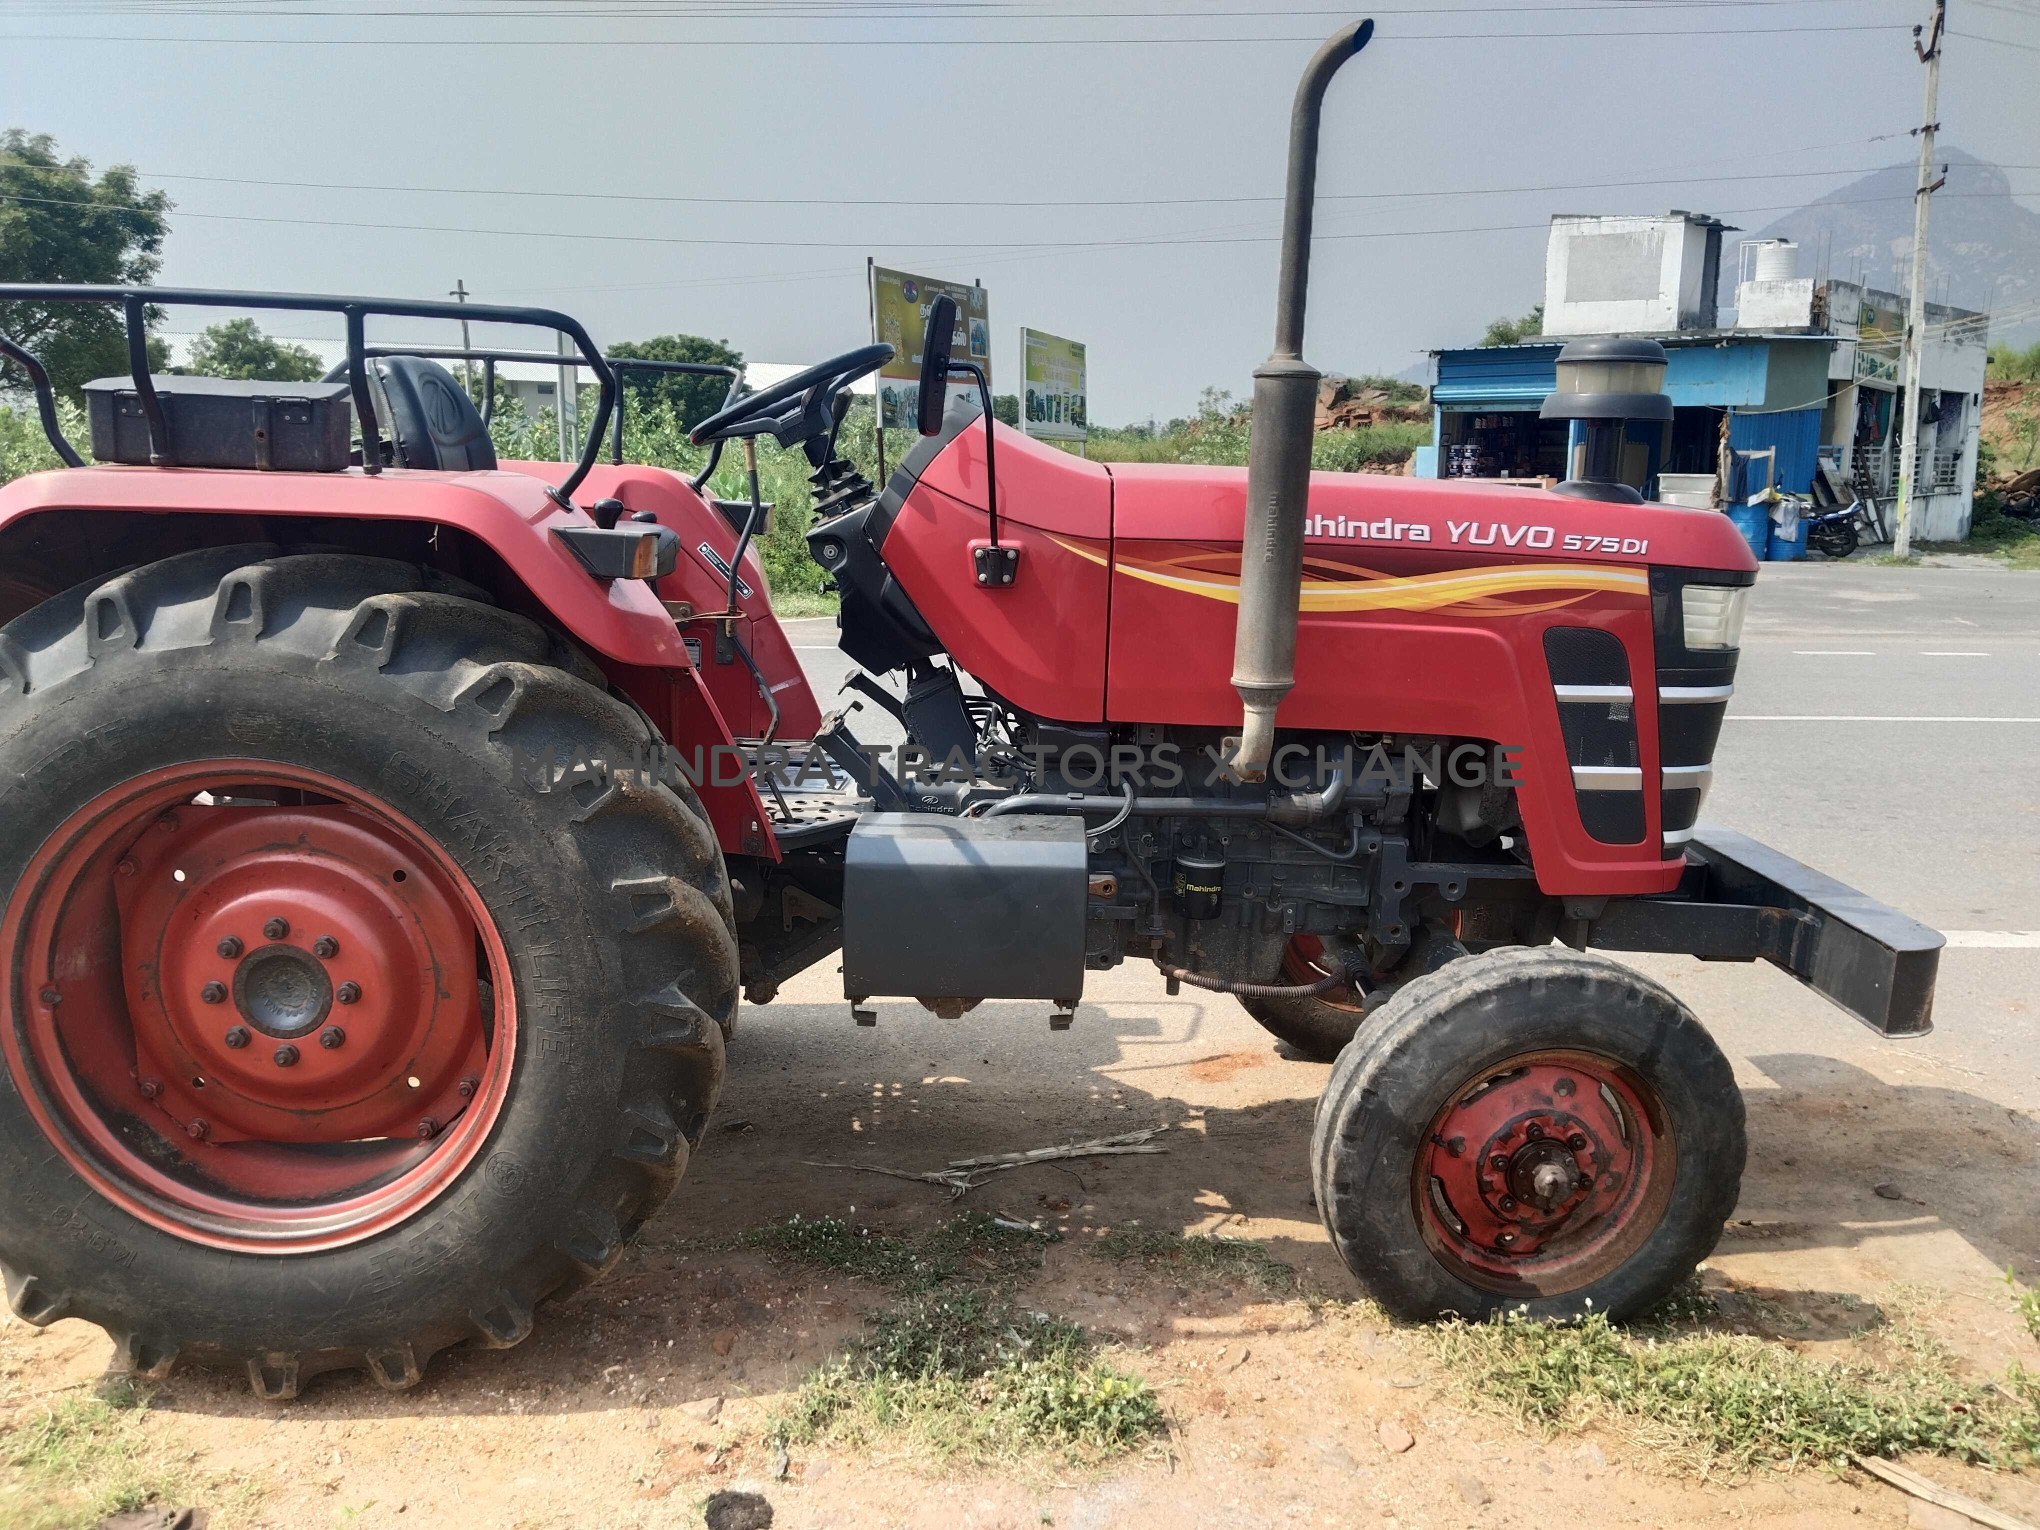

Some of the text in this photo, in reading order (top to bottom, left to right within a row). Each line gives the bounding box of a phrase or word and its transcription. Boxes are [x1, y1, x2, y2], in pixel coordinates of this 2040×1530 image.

[1304, 514, 1649, 555] hindra YUVO 575DI
[383, 750, 574, 1065] SHAKTI LIFE
